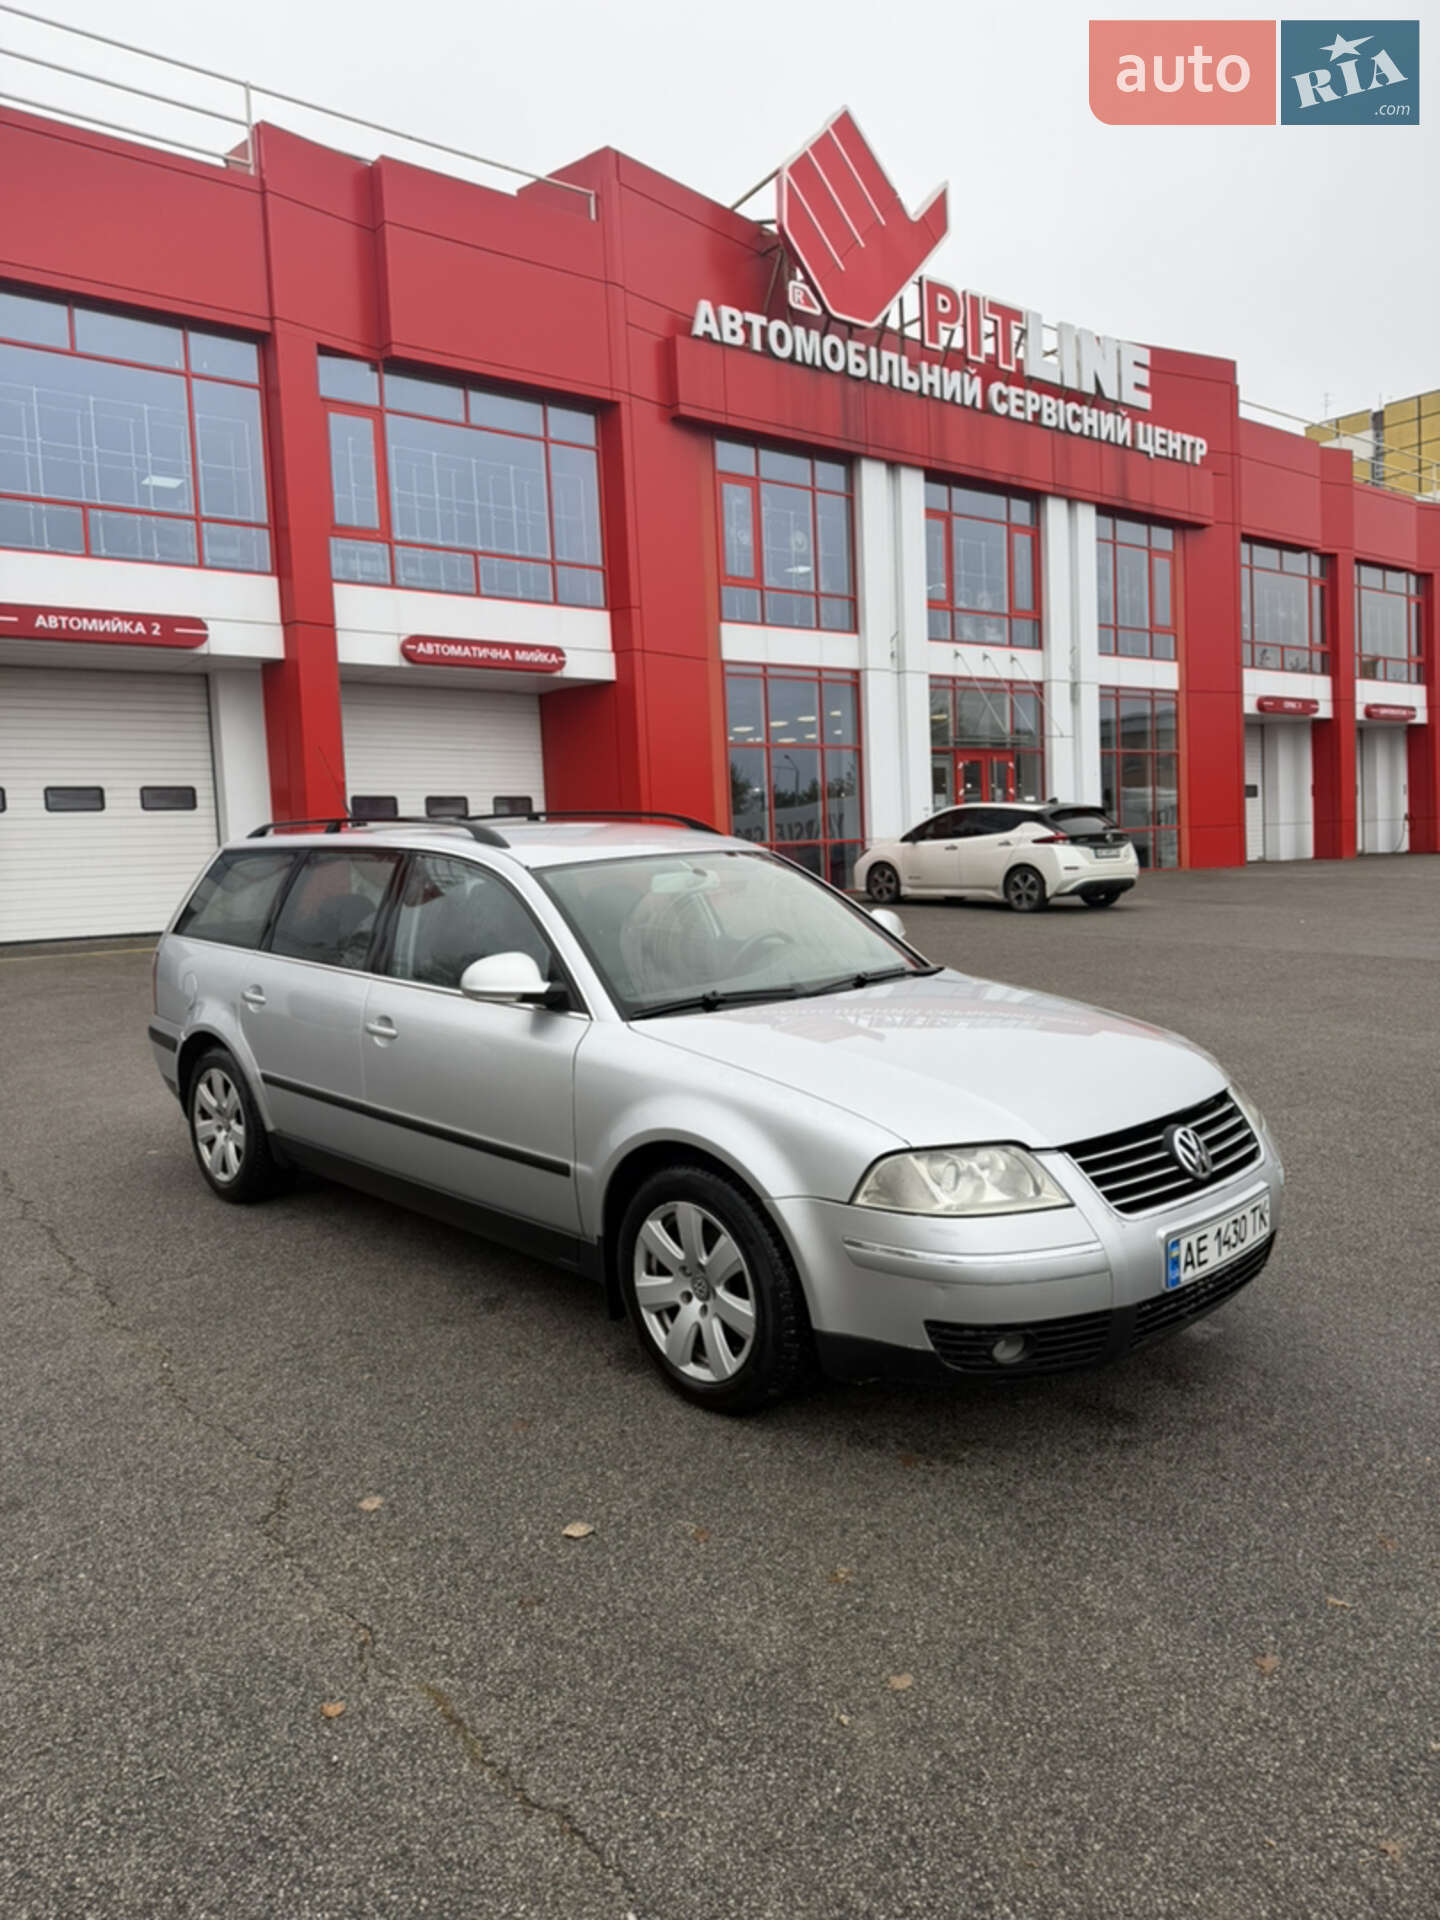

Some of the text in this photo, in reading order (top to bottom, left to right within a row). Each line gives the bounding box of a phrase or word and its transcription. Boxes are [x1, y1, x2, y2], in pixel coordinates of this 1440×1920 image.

[920, 274, 1152, 411] PITLINE
[691, 298, 1208, 466] АВТОМОБІЛЬНИЙ СЕРВІСНИЙ ЦЕНТР
[34, 613, 161, 637] АВТОМИЙКА 2
[416, 641, 559, 665] АВТОМАТИЧНА МИЙКА
[1183, 1203, 1268, 1274] AE 1430 TK
